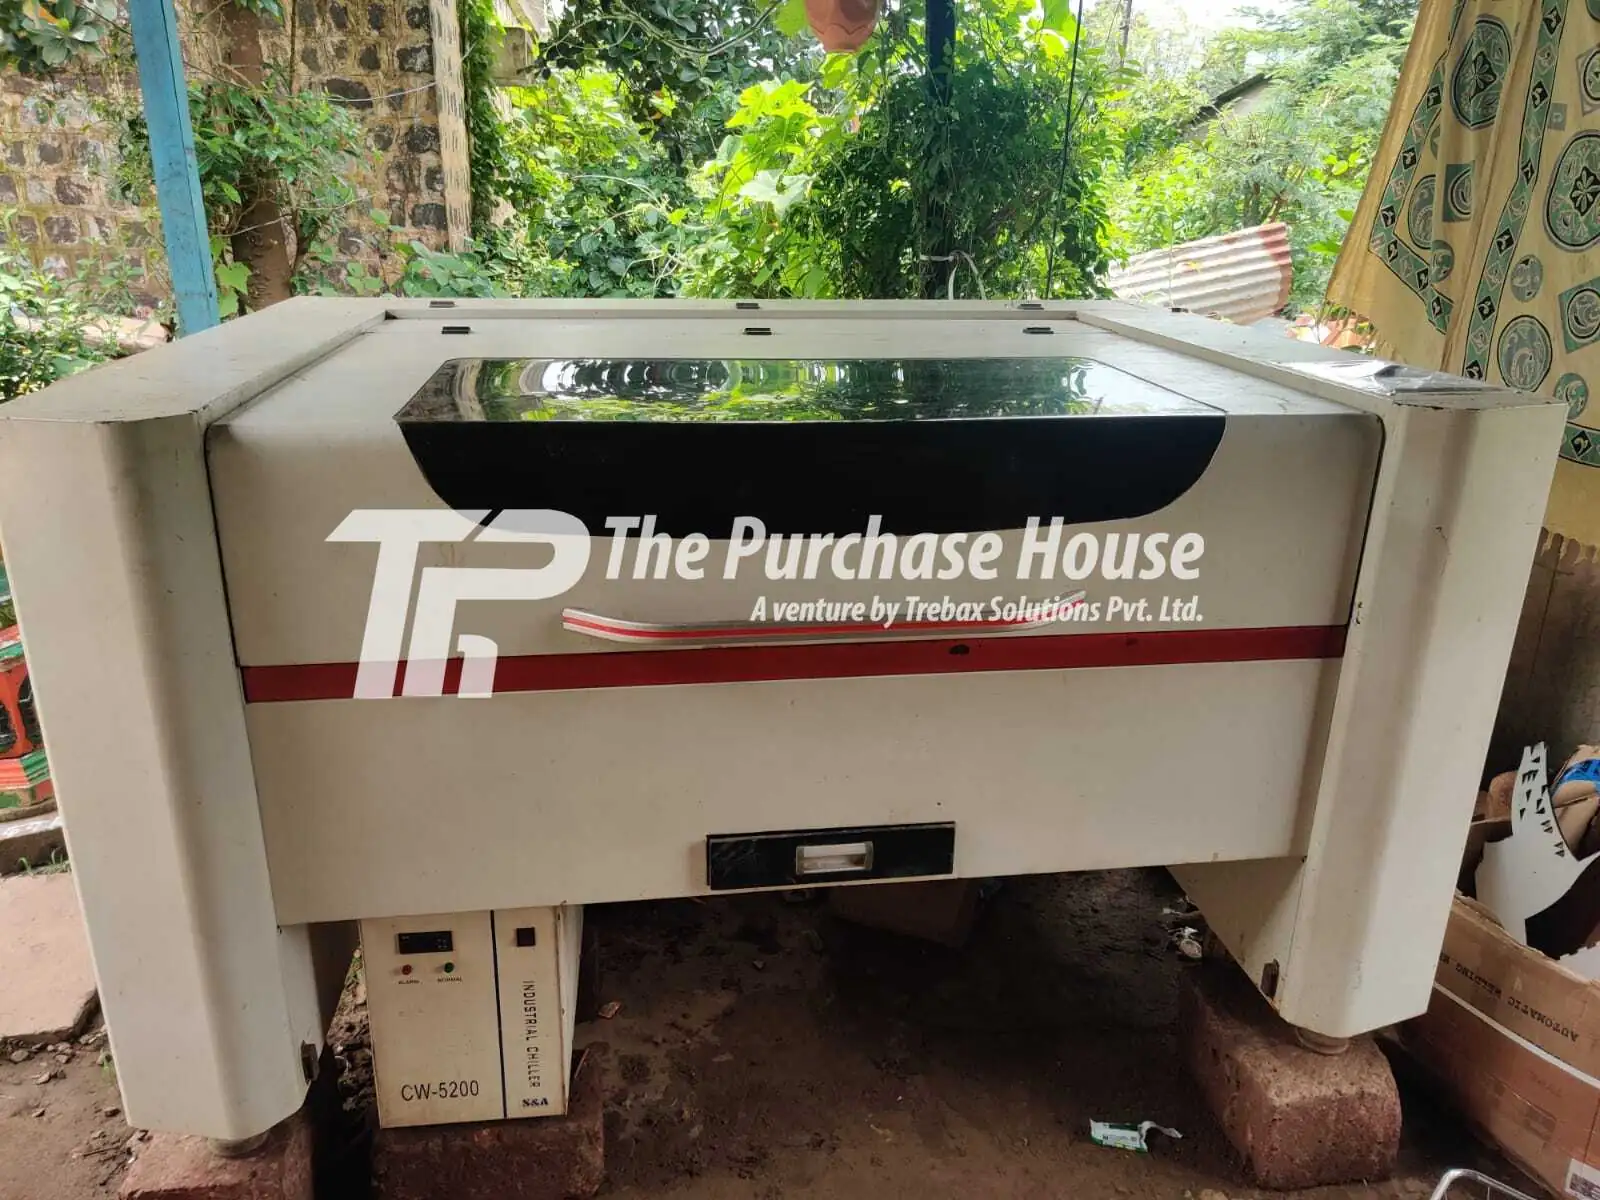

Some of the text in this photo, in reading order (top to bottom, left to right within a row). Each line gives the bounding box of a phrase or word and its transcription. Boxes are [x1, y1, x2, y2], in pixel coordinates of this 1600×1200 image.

[522, 980, 541, 1088] INDUSTRIAL CHILLER
[1507, 996, 1579, 1042] AUTOMATIC
[401, 1080, 480, 1101] CW-5200
[522, 1097, 549, 1108] S&A
